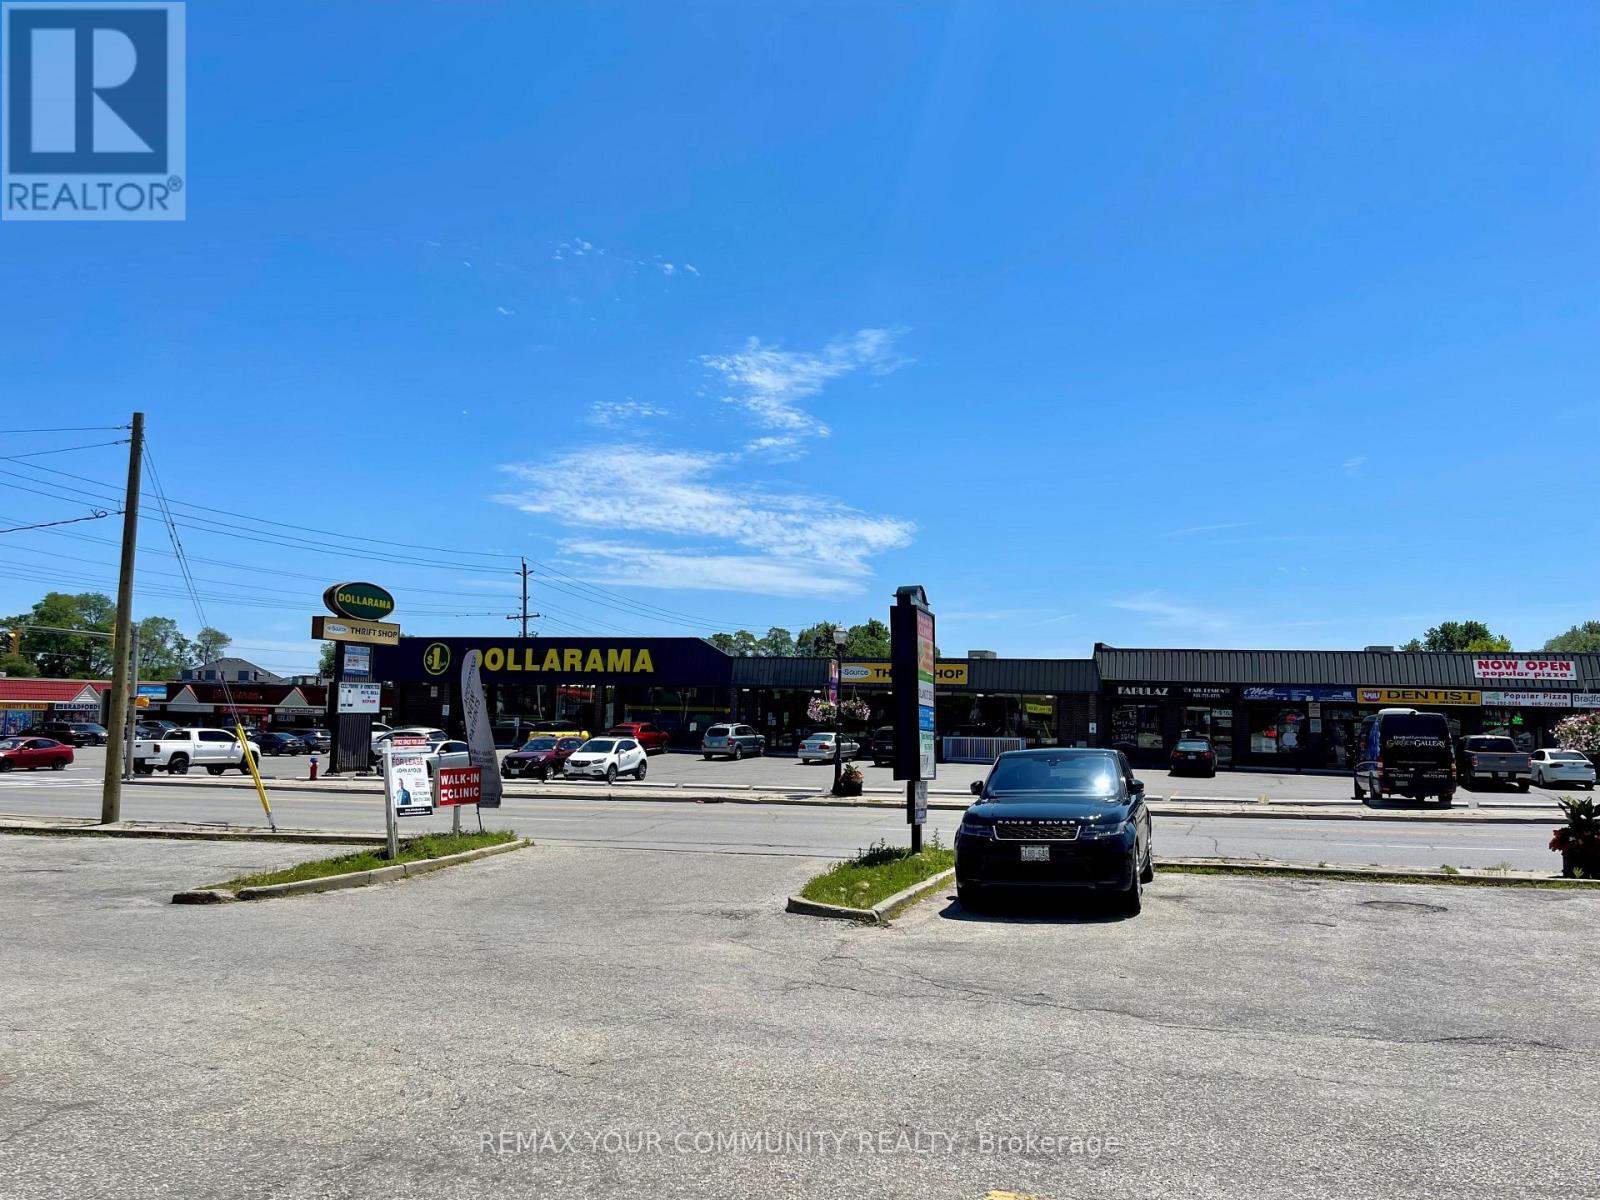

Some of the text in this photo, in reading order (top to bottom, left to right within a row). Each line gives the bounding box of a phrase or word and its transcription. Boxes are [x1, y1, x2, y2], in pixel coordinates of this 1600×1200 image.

[338, 593, 392, 609] DOLLARAMA
[350, 627, 377, 636] THRIFT
[377, 629, 398, 638] SHOP
[1477, 661, 1571, 671] NOW OPEN
[1386, 690, 1478, 701] DENTIST
[1503, 692, 1540, 700] Popular
[392, 757, 424, 766] FOR LEASE
[440, 773, 480, 786] WALK-IN
[447, 787, 480, 799] CLINIC
